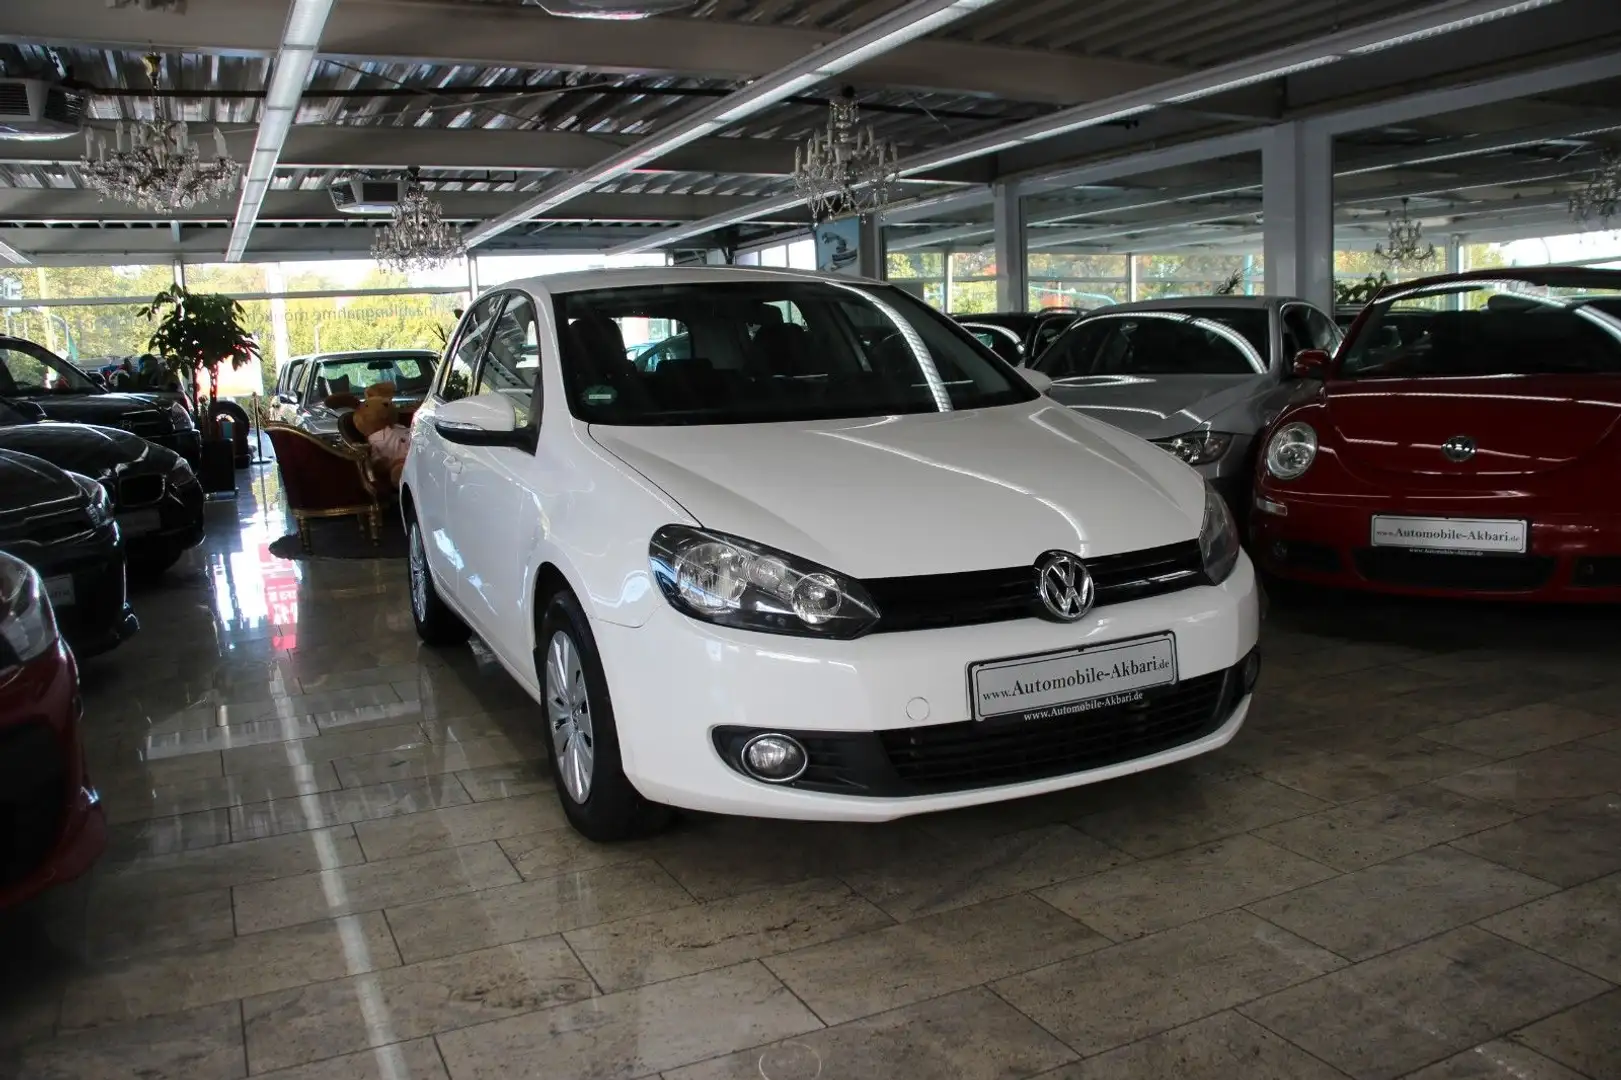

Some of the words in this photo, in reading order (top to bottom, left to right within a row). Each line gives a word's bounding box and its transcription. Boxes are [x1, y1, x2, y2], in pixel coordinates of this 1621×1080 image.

[1041, 556, 1095, 620] VW
[983, 656, 1170, 701] www.Automobile-Akbari.de
[1024, 691, 1143, 721] www.Automobile-Akbari.de
